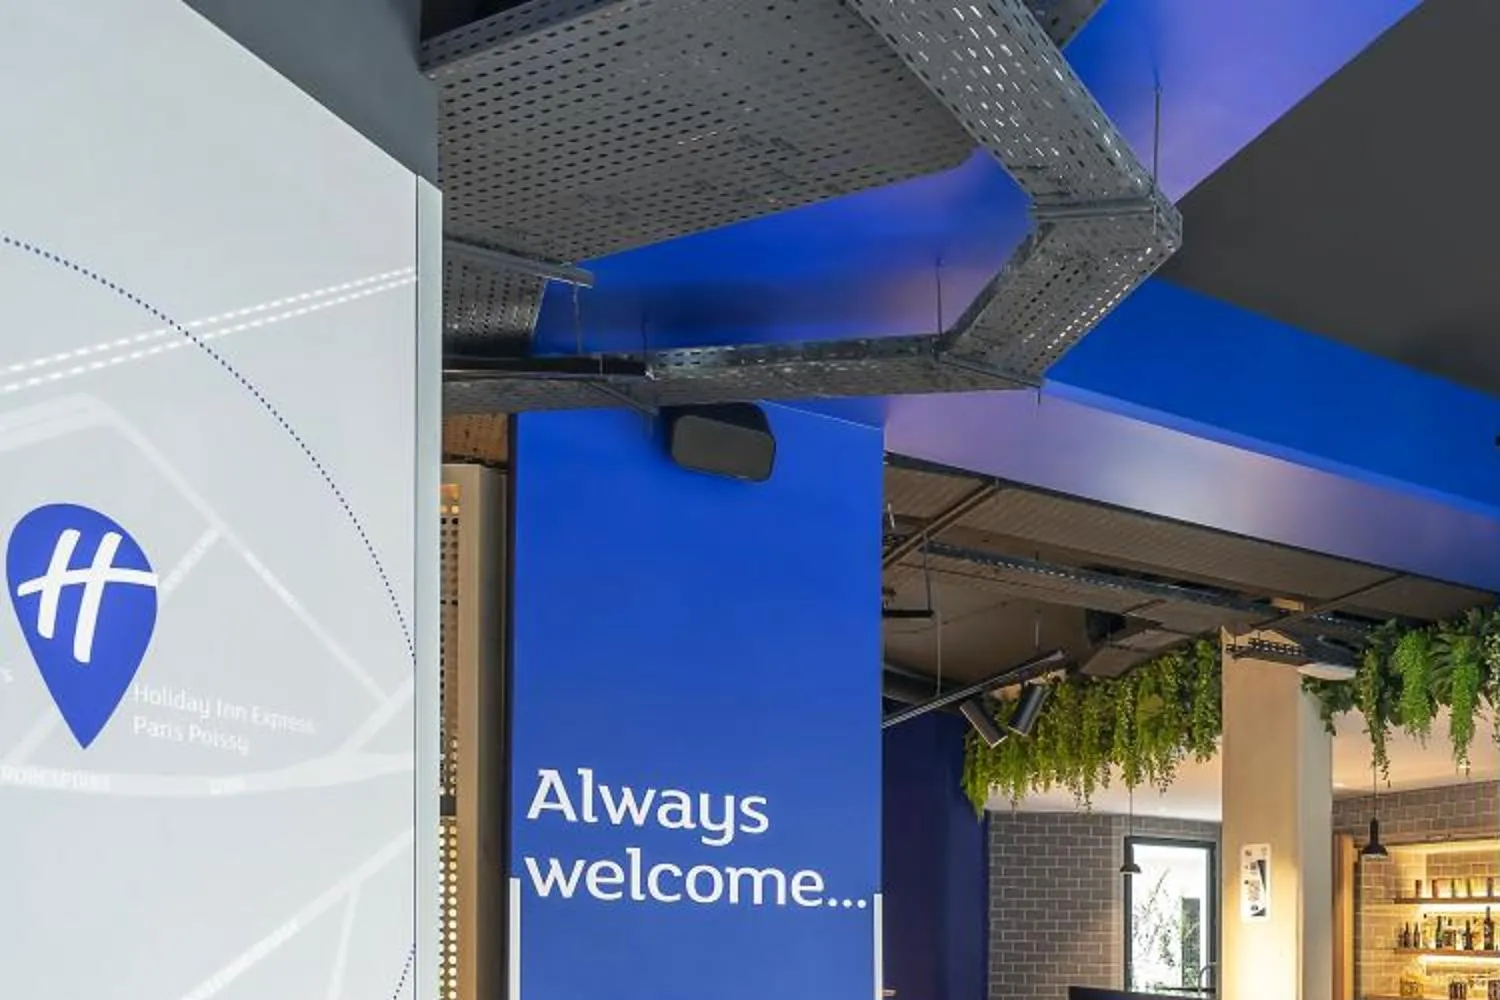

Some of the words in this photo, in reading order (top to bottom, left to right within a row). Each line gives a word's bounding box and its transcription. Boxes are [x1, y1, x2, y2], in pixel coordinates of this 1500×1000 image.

[133, 684, 210, 720] Holiday
[215, 699, 248, 722] Inn
[133, 715, 184, 742] Paris
[188, 723, 249, 756] Poissy
[526, 767, 770, 847] Always
[523, 846, 868, 909] welcome...
